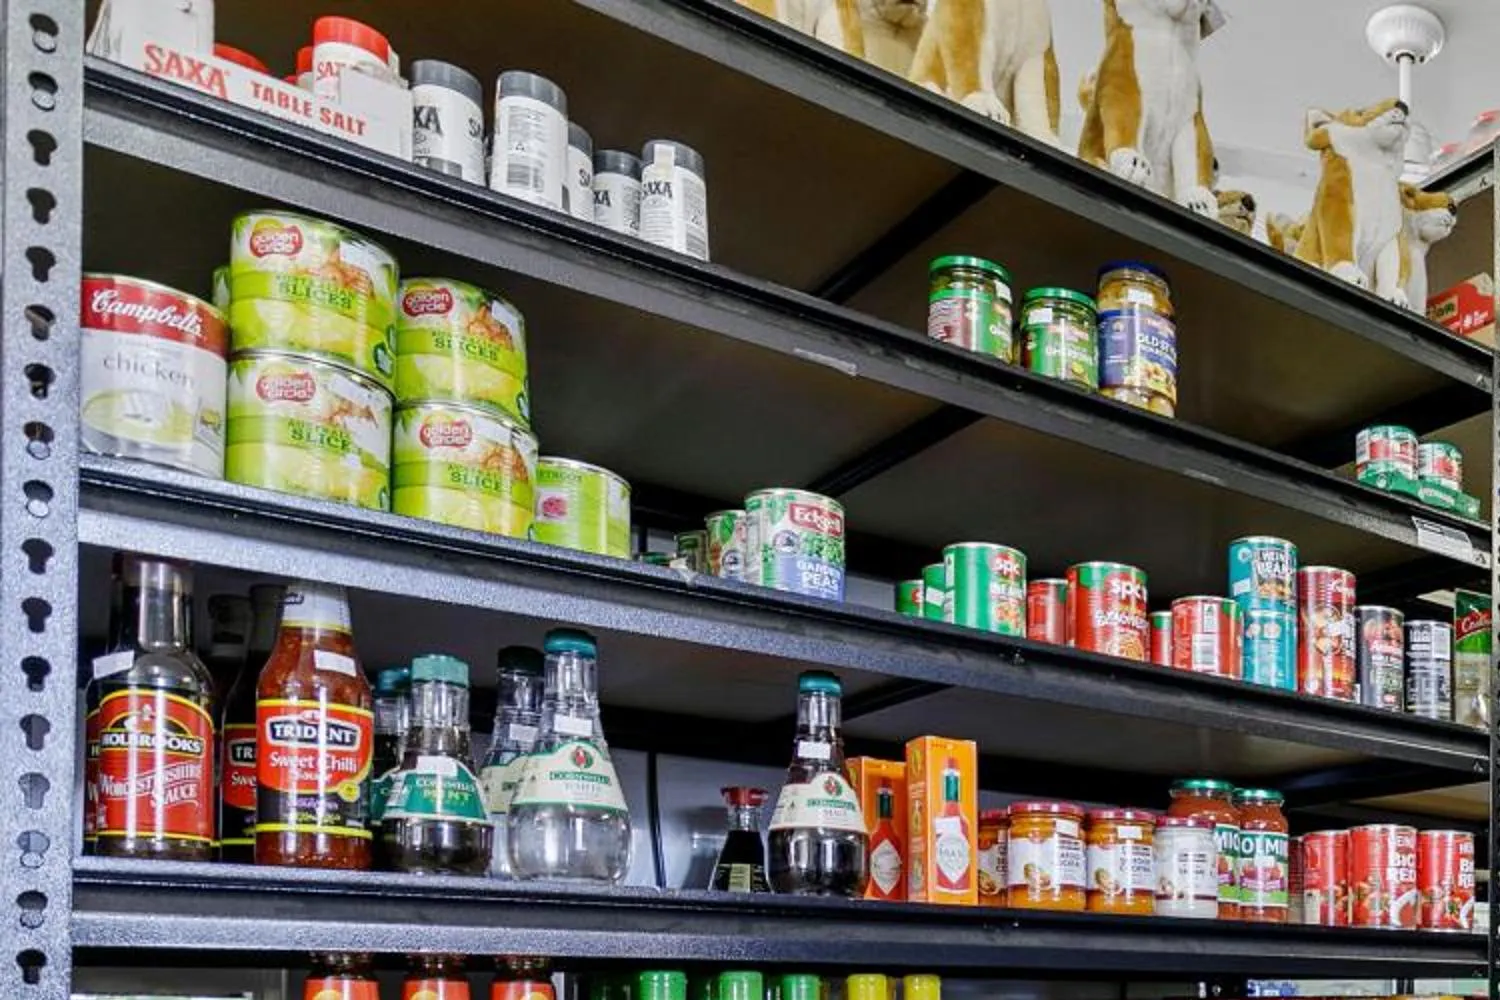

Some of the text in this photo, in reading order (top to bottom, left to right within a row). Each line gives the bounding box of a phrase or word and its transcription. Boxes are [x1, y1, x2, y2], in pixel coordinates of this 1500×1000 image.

[143, 42, 228, 98] SAXA
[250, 81, 366, 136] TABLE SALT
[103, 351, 196, 388] chicken
